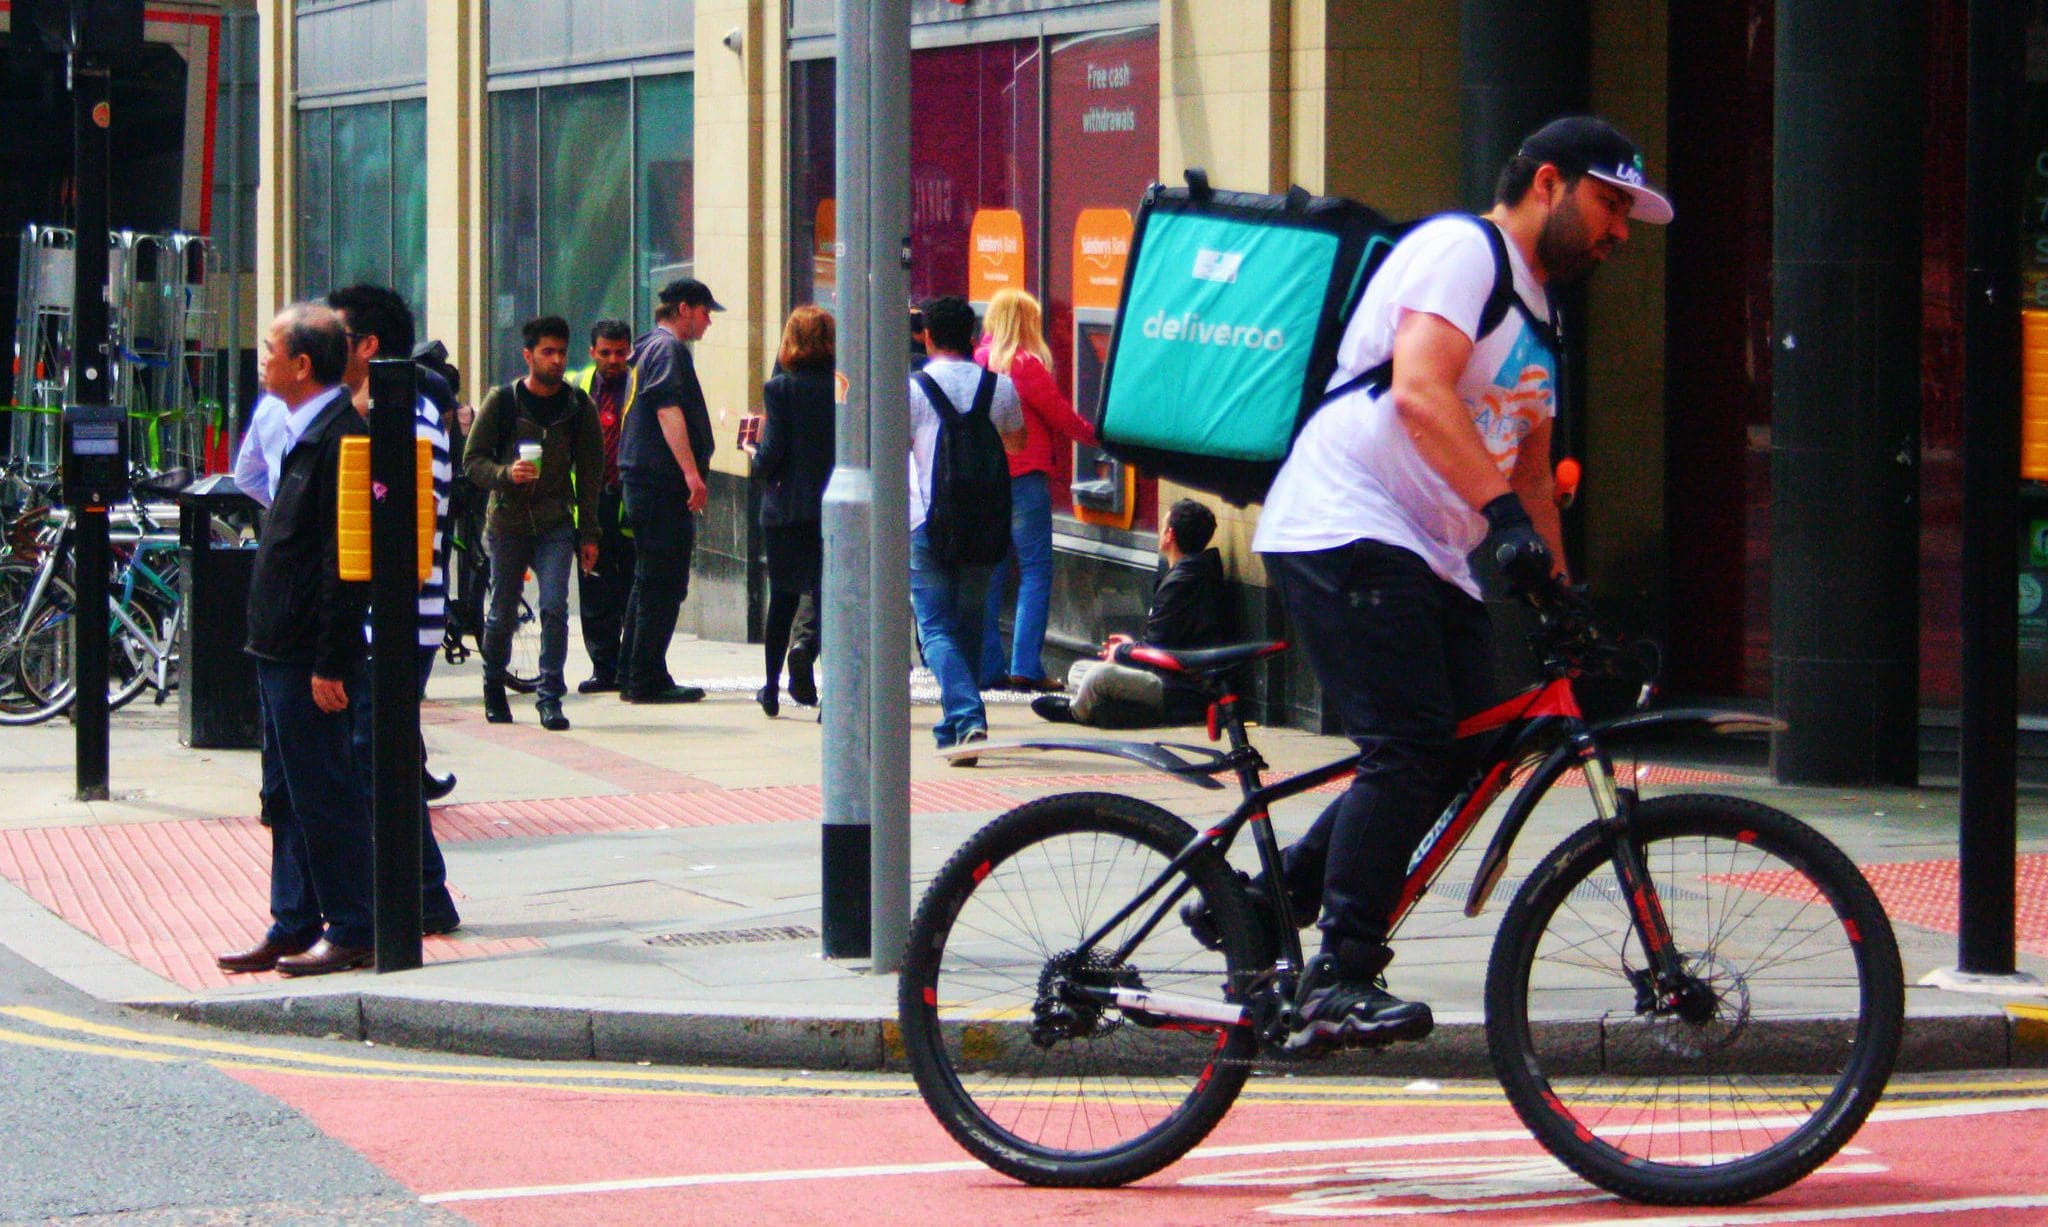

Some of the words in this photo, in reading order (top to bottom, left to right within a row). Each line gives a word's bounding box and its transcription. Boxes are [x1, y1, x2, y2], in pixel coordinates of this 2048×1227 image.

[1087, 64, 1107, 90] Free
[1108, 62, 1130, 89] cash
[1082, 105, 1136, 133] withdrawals
[1142, 309, 1285, 351] deliveroo
